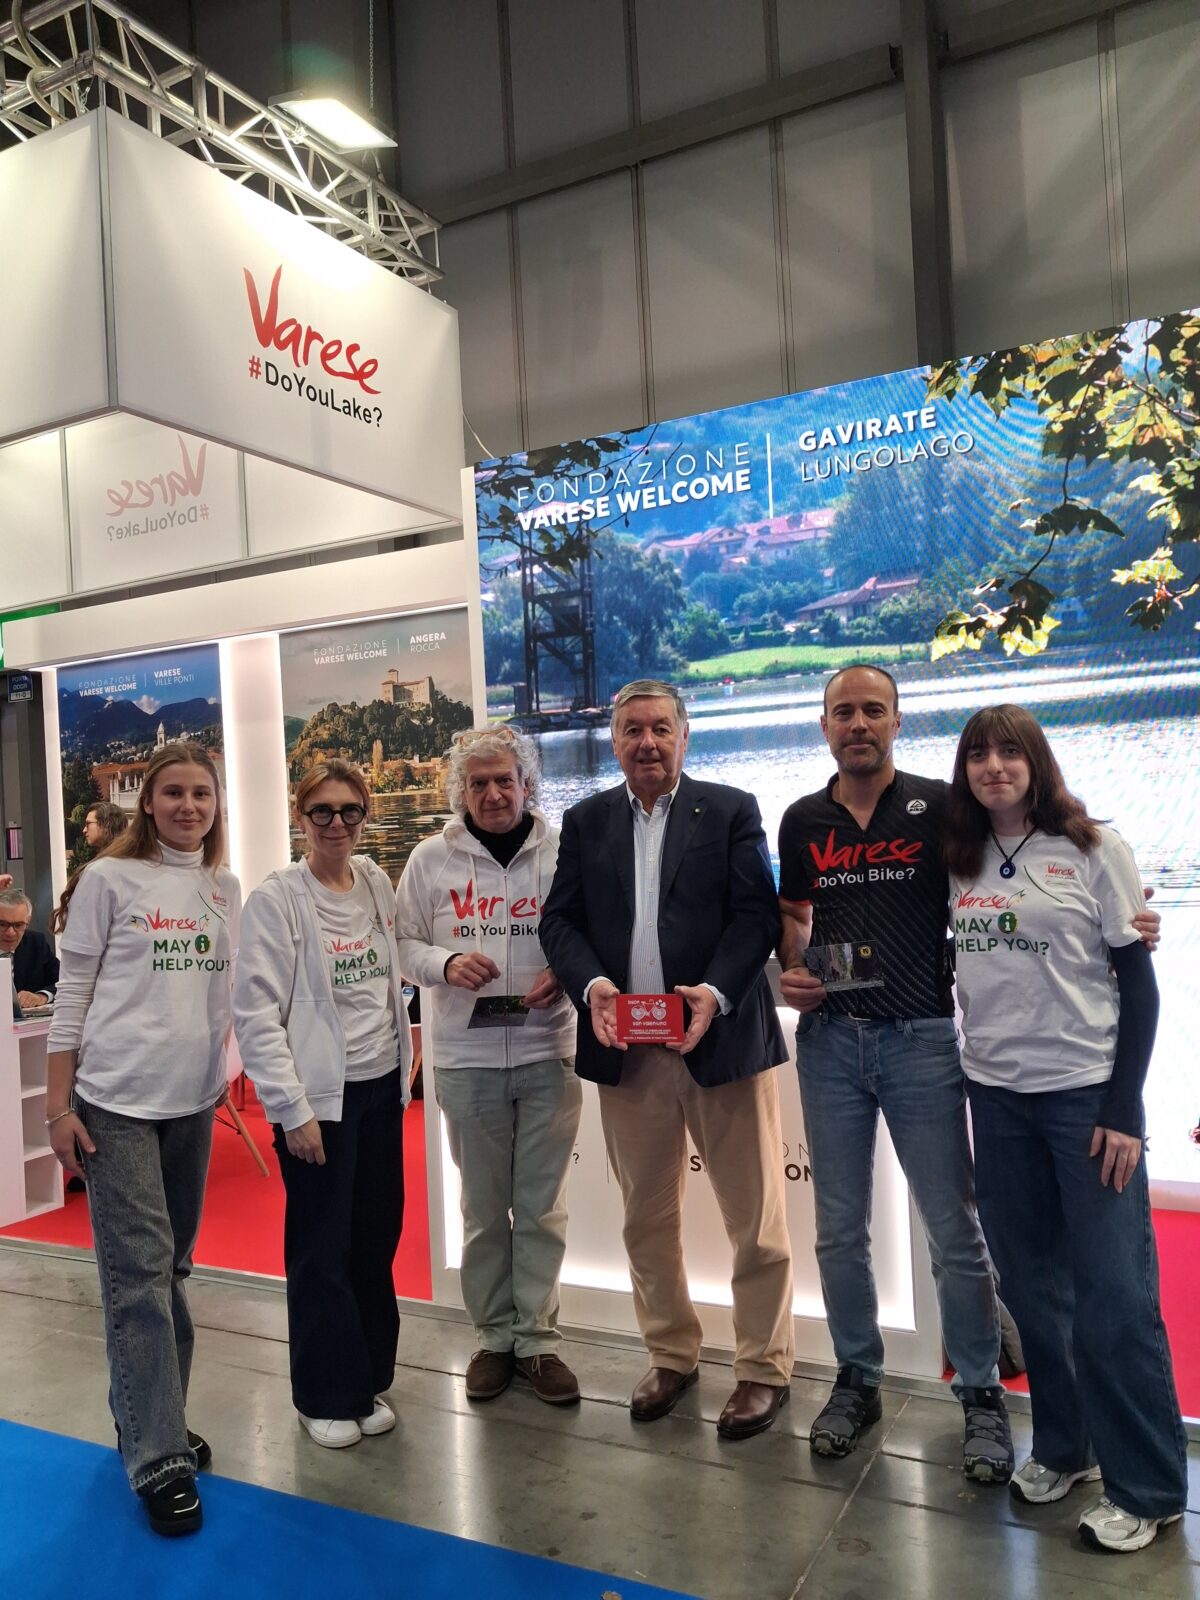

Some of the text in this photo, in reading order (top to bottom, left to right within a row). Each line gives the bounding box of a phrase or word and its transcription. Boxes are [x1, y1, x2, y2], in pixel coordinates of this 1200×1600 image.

[243, 264, 382, 395] Varese
[248, 355, 383, 427] #DoYouLake?
[798, 406, 937, 451] GAVIRATE
[800, 431, 975, 483] LUNGOLAGO
[517, 442, 750, 507] FONDAZIONE
[517, 469, 751, 531] VARESE WELCOME
[409, 632, 446, 644] ANGERA
[313, 640, 388, 656] FONDAZIONE
[410, 642, 440, 654] ROCCA
[314, 649, 388, 665] VARESE WELCOME
[153, 668, 181, 678] VARESE
[154, 674, 195, 687] VILLE PONTI
[78, 674, 137, 689] FONDAZIONE
[79, 682, 137, 697] VARESE WELCOME
[808, 828, 923, 872] Varese
[449, 877, 545, 920] Vares
[145, 906, 198, 930] Varese
[955, 918, 993, 934] MAY
[153, 939, 191, 954] MAY
[956, 938, 1050, 955] HELP YOU?
[153, 958, 230, 972] HELP YOU?
[335, 955, 364, 972] MAY
[335, 970, 367, 985] HELP
